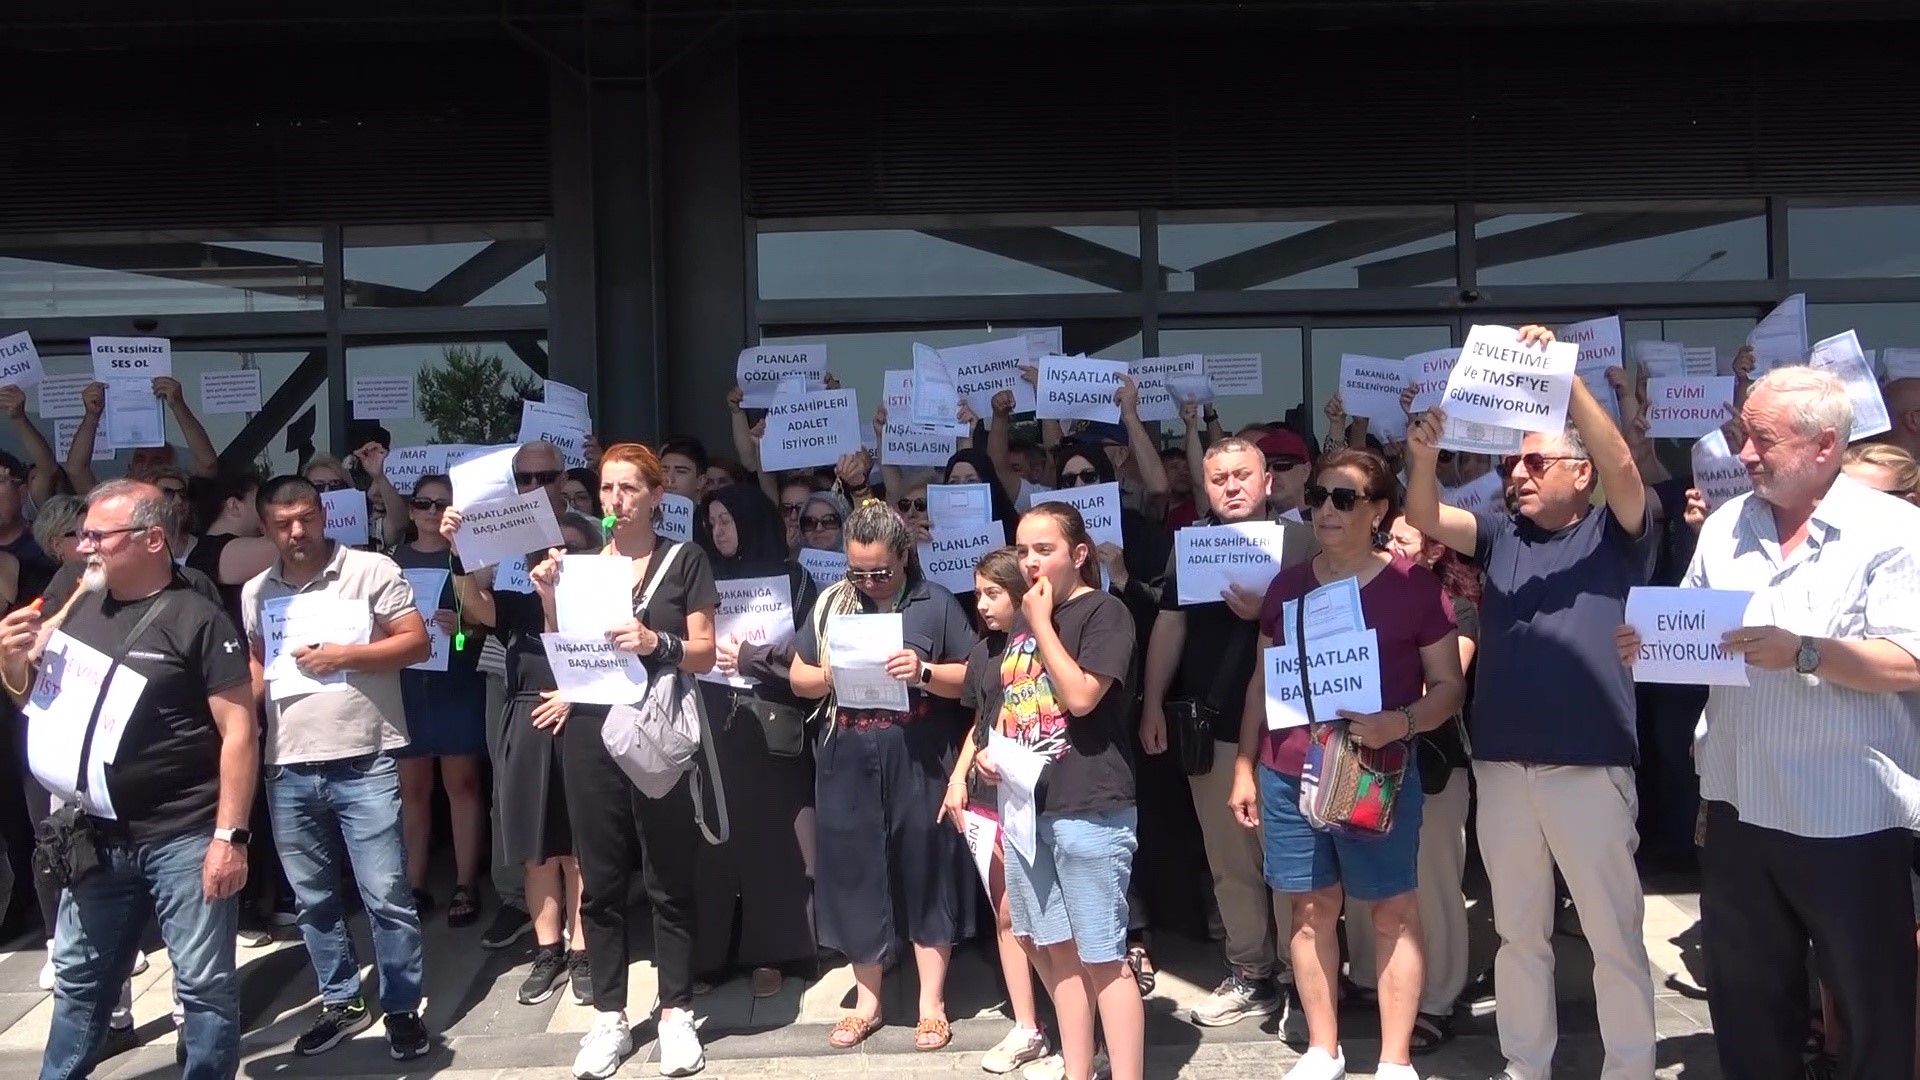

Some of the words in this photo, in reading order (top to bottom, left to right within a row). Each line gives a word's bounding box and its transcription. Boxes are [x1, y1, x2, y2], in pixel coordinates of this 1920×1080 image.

[97, 345, 114, 353] GEL
[117, 345, 163, 354] SESİMİZE
[111, 359, 131, 368] SES
[134, 359, 149, 368] OL
[756, 353, 808, 364] PLANLAR
[1141, 361, 1195, 374] SAHİPLERİ
[1355, 368, 1401, 381] BAKANLIĞA
[809, 371, 820, 380] !!!
[1005, 377, 1016, 387] !!!
[1046, 366, 1120, 385] İNŞAATLAR
[1463, 364, 1478, 379] Ve
[1482, 368, 1550, 393] TMSF'YE
[1049, 391, 1112, 405] BAŞLASIN
[1665, 384, 1706, 399] EVİMİ
[767, 405, 788, 417] HAK
[790, 396, 848, 414] SAHİPLERİ
[1450, 386, 1551, 416] GÜVENİYORUM
[1651, 406, 1725, 420] İSTİYORUM
[788, 417, 829, 432] ADALET
[540, 432, 575, 449] EVİMİ
[782, 436, 825, 450] İSTİYOR
[827, 434, 837, 445] !!!
[888, 441, 950, 455] BAŞLASIN
[385, 465, 440, 475] PLANLARI
[460, 500, 541, 524] NŞAATLARIMIZ
[472, 515, 536, 535] BAŞLASIN!!!
[931, 535, 990, 552] PLANLAR
[1190, 538, 1212, 547] HAK
[1187, 554, 1226, 565] ADALET
[1657, 609, 1706, 631] EVİMİ
[568, 658, 629, 670] BAŞLASIN!!!
[1275, 646, 1370, 675] İNŞAATLAR
[1281, 676, 1363, 702] BALASIN
